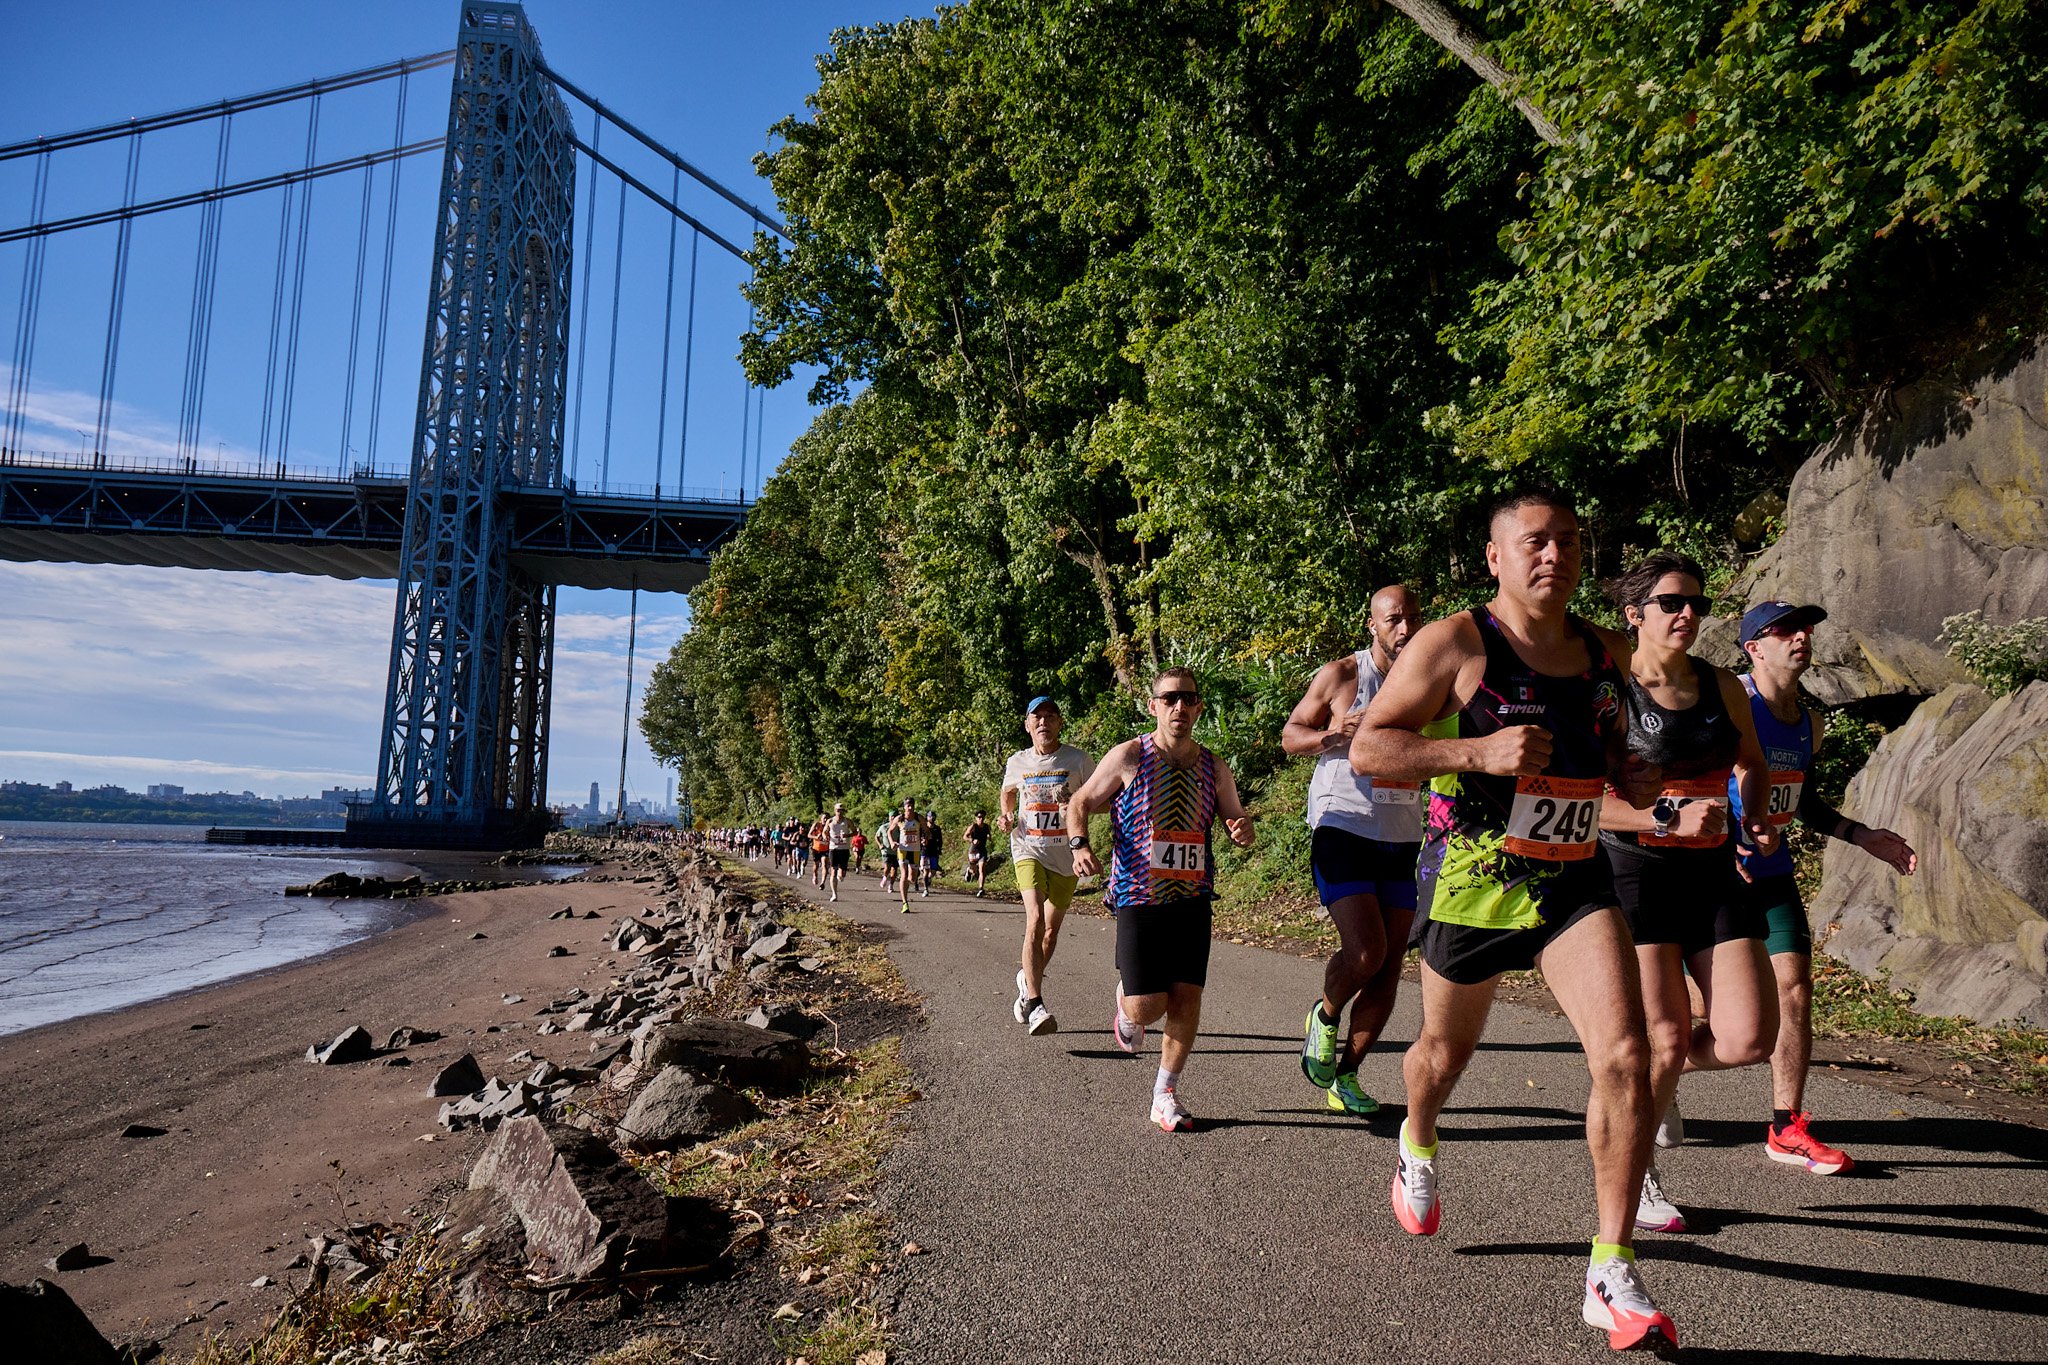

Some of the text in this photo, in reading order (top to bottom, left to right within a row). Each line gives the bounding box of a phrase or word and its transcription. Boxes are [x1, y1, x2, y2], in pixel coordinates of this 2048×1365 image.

[1498, 704, 1545, 714] SIMON
[1646, 716, 1657, 728] B
[1771, 750, 1798, 764] NORTH
[1769, 785, 1791, 814] 30
[1034, 812, 1060, 829] 174
[1528, 798, 1594, 843] 249
[1161, 843, 1197, 869] 415
